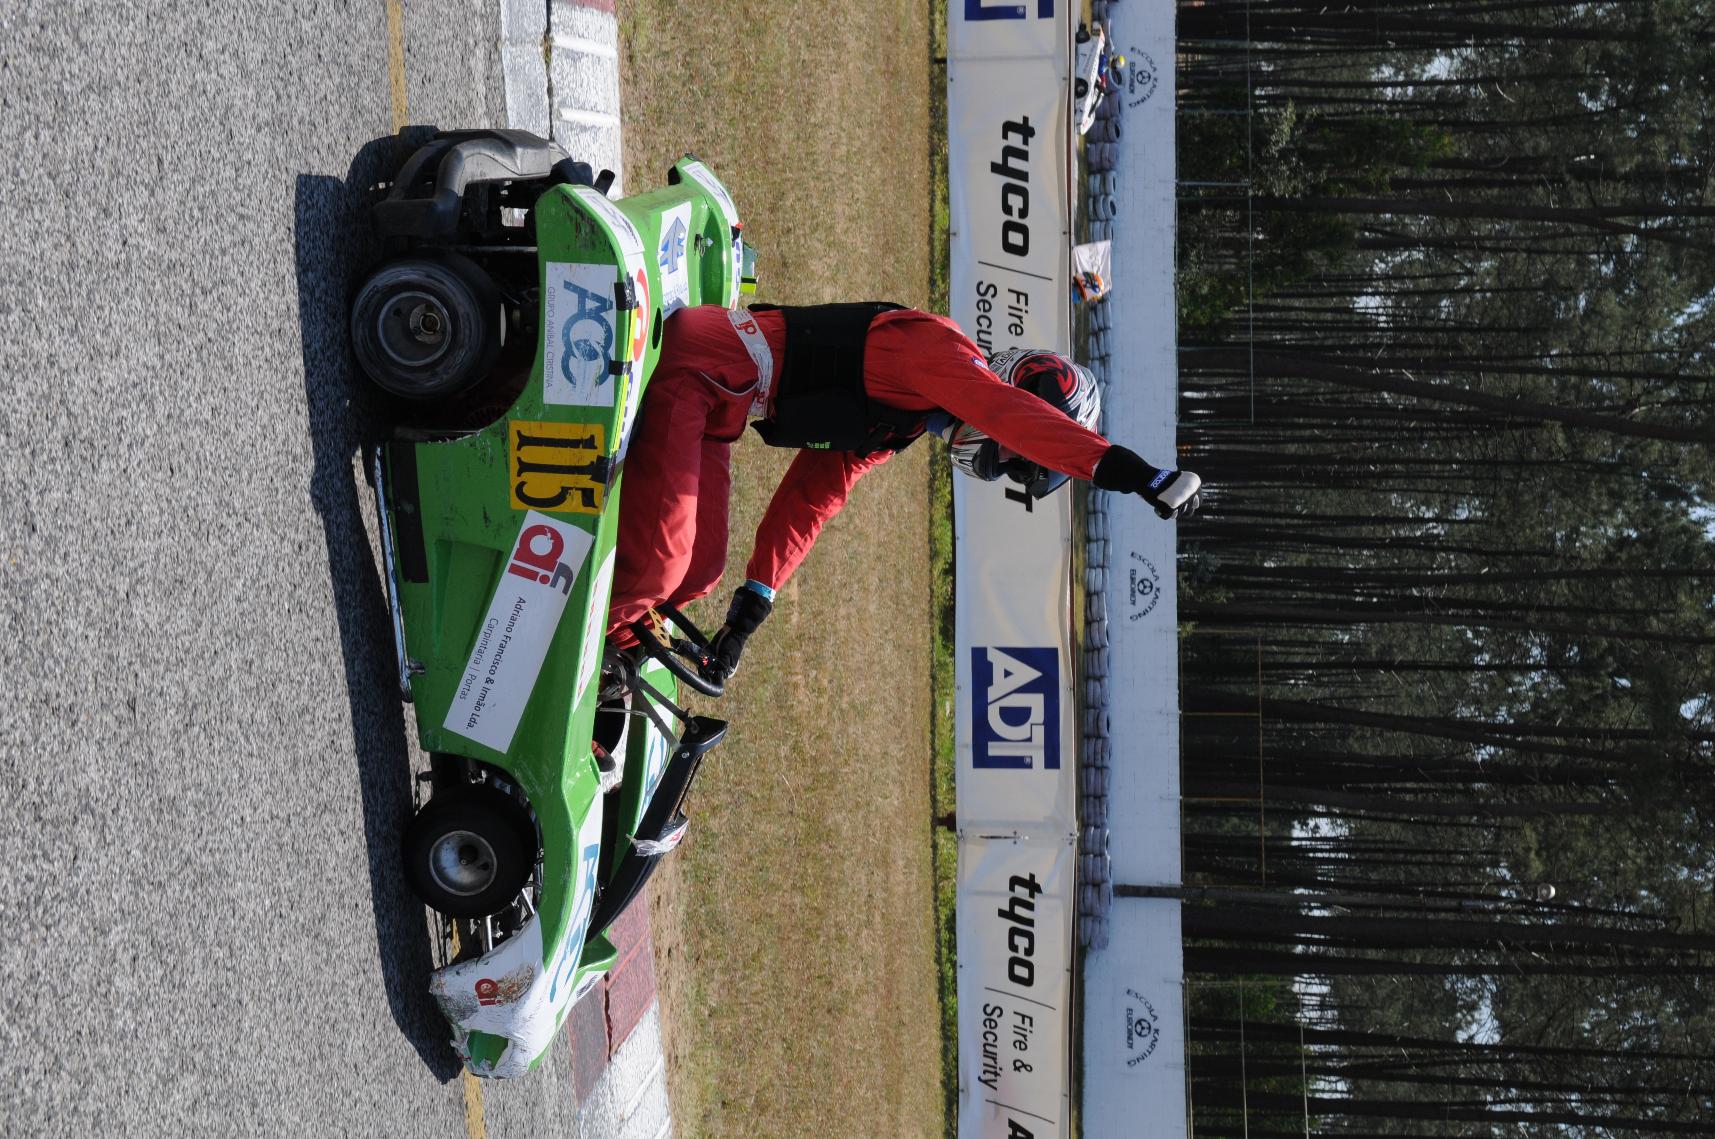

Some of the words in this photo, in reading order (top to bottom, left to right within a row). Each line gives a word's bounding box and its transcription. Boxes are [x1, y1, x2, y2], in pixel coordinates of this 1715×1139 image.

[990, 115, 1036, 258] tyco
[546, 286, 556, 318] GRUPO
[1007, 288, 1029, 337] Fire
[544, 351, 555, 389] CRISTINA
[515, 429, 599, 509] 115
[1130, 551, 1160, 582] ESCOLA
[1129, 568, 1137, 607] EUROINDY
[1129, 587, 1161, 622] KARTING
[504, 596, 527, 633] Adriano
[473, 617, 499, 665] Carpintaria
[488, 634, 512, 676] Francisco
[459, 673, 477, 701] Portas
[473, 686, 491, 712] Irmão
[485, 676, 495, 685] &
[465, 712, 480, 731] Lda.
[987, 646, 1045, 769] ADT
[997, 872, 1043, 987] tyco
[1126, 988, 1159, 1023] ESCOLA
[977, 1003, 1004, 1091] Security
[1012, 1010, 1033, 1051] Fire
[1126, 1007, 1134, 1050] EUROINDY
[1127, 1027, 1160, 1068] KARTING
[1012, 1059, 1033, 1074] &
